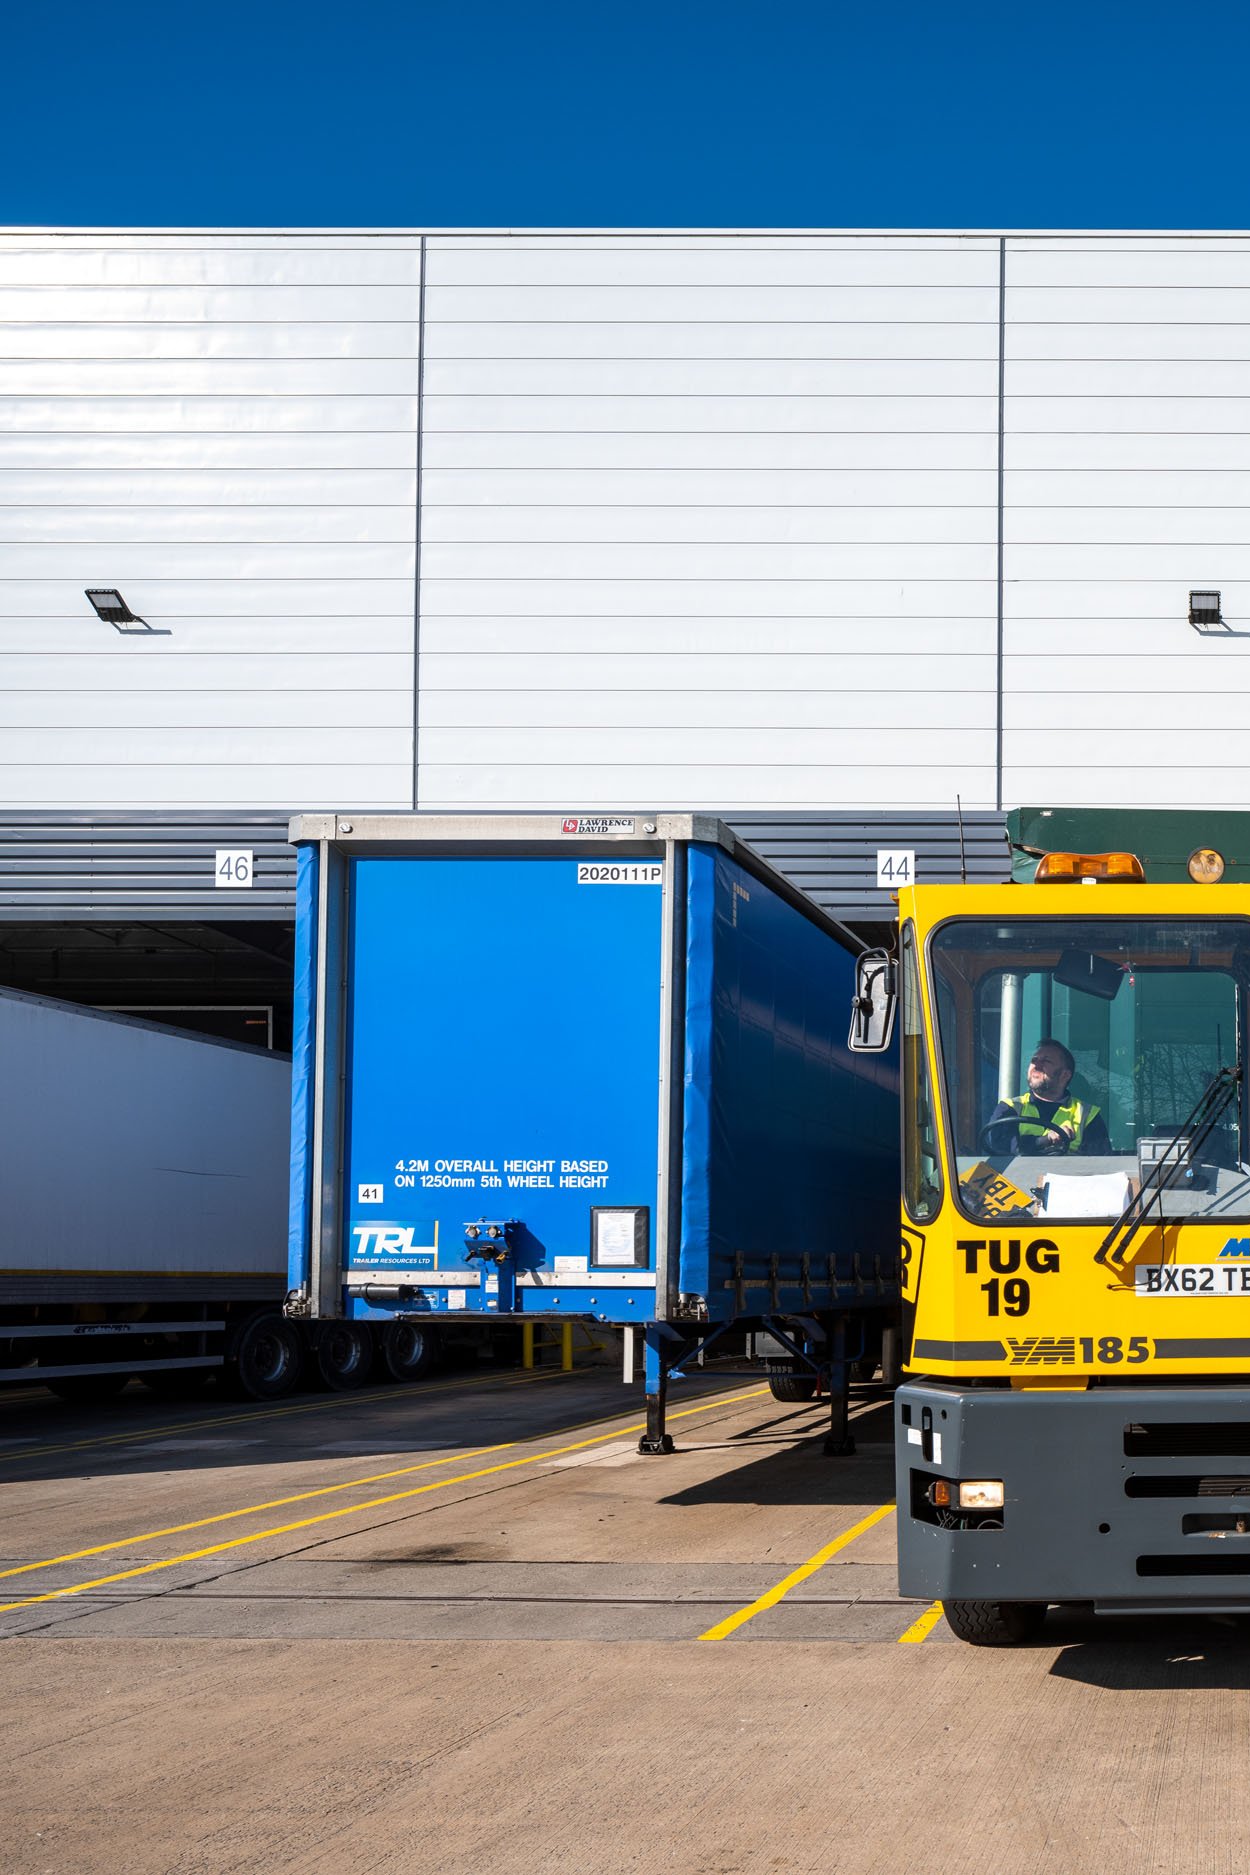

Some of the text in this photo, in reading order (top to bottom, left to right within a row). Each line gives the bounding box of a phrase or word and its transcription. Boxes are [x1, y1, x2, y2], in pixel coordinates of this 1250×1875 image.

[579, 819, 634, 827] LAWRENCE
[219, 856, 248, 881] 46
[579, 867, 661, 881] 2020111P
[881, 856, 910, 881] 44
[395, 1160, 609, 1173] 4.2M OVERALL HEIGHT BASED
[362, 1188, 378, 1199] 41
[394, 1175, 609, 1188] ON 1250mm 5th WHEEL HEIGHT
[352, 1227, 438, 1254] TRL
[956, 1239, 1060, 1274] TUG
[1146, 1268, 1214, 1292] BX62
[980, 1277, 1031, 1317] 19
